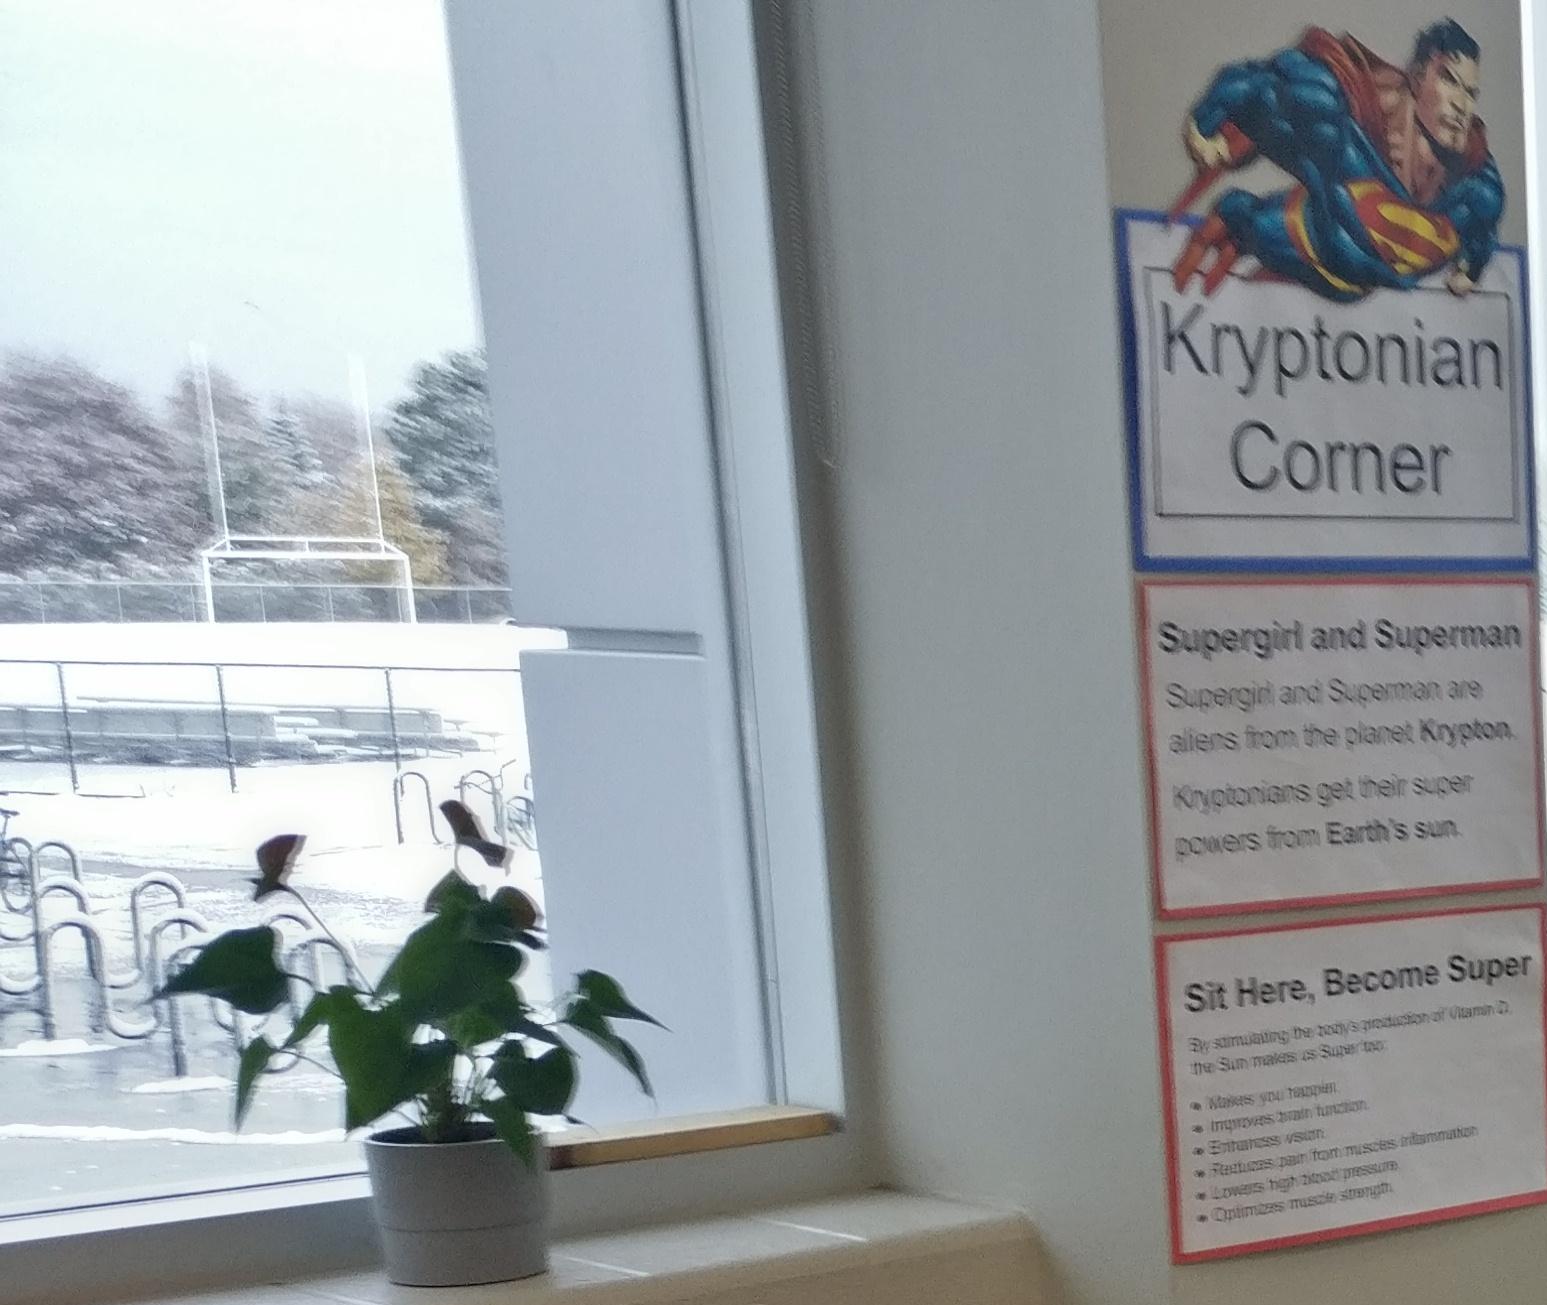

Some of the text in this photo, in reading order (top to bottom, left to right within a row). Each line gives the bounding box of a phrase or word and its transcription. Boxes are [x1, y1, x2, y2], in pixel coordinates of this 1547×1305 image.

[1161, 302, 1503, 397] Kryptonian
[1231, 420, 1454, 495] Corner
[1158, 618, 1522, 659] Supergirl and Superman
[1166, 677, 1483, 712] Supergirl and Superman are
[1168, 717, 1516, 754] aliens from the planet Krypton.
[1317, 779, 1354, 806] get
[1359, 774, 1408, 798] their
[1413, 773, 1475, 799] super
[1174, 832, 1261, 862] powers
[1266, 824, 1320, 850] from
[1325, 819, 1409, 847] Earth's
[1184, 982, 1226, 1013] Sit
[1234, 975, 1316, 1008] Here,
[1322, 960, 1440, 998] Become
[1446, 950, 1533, 987] Super
